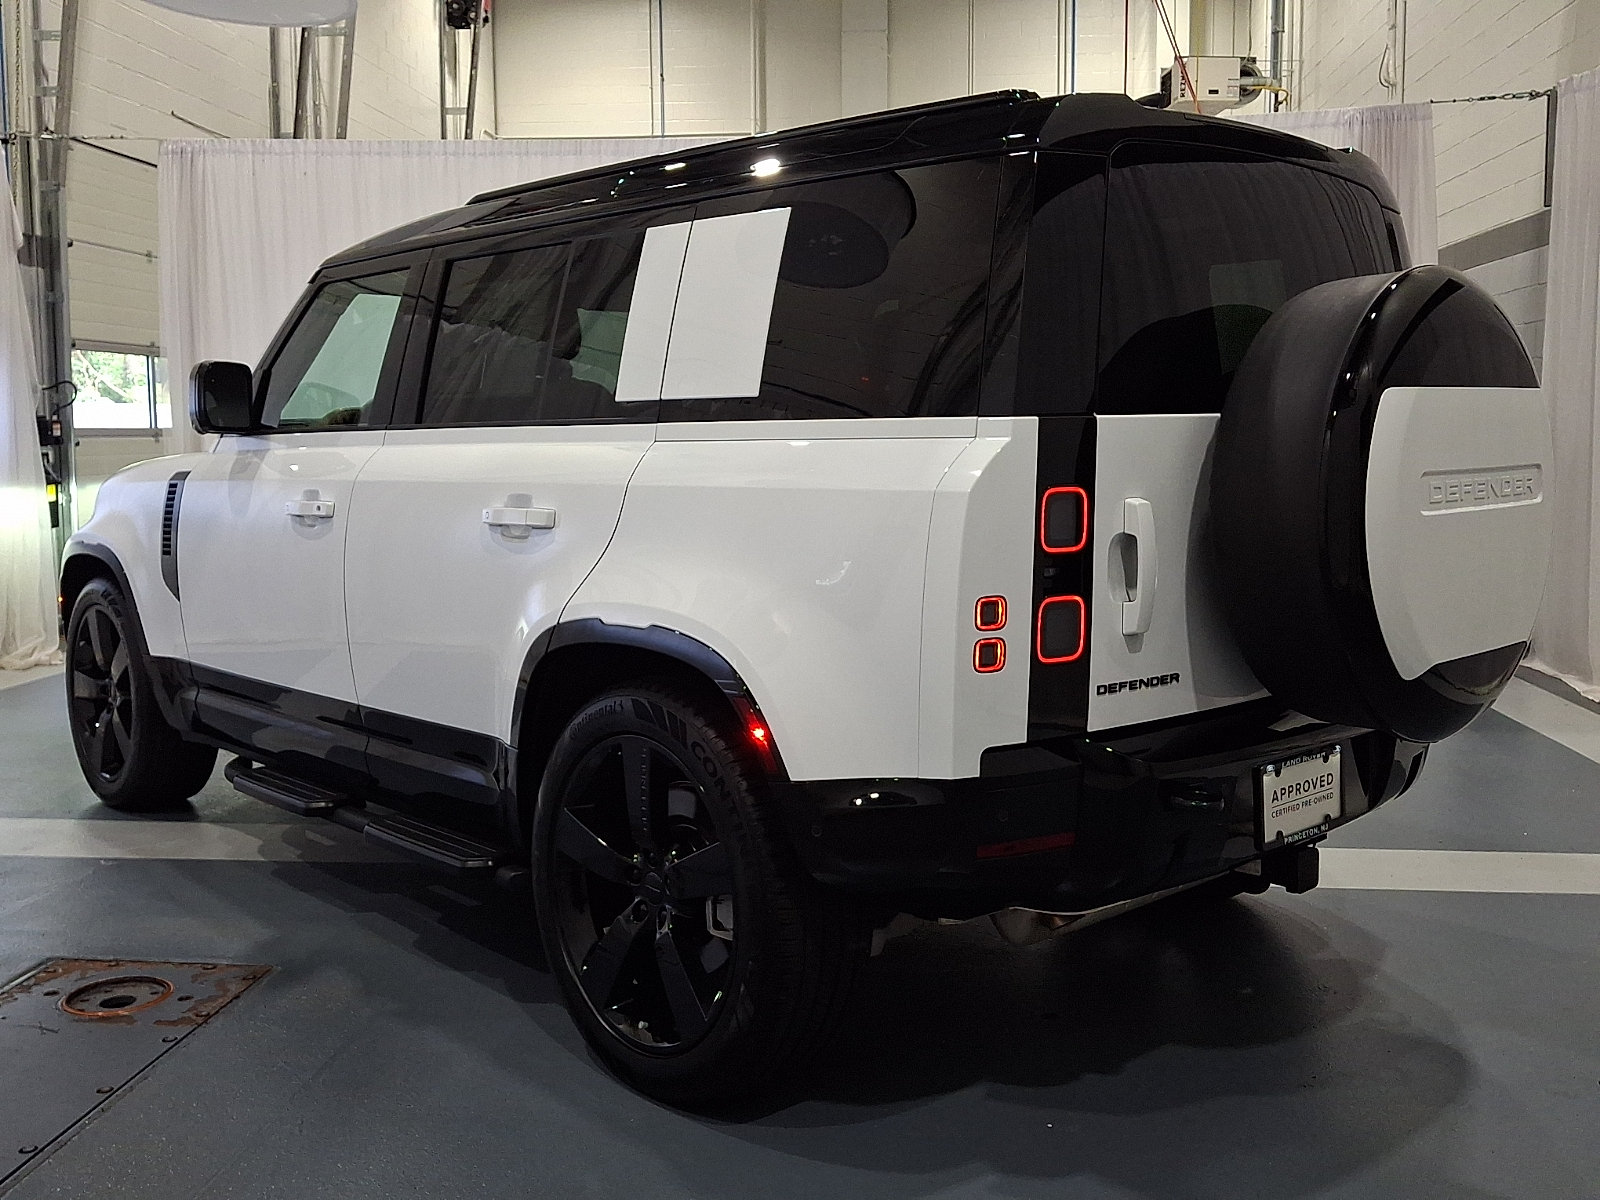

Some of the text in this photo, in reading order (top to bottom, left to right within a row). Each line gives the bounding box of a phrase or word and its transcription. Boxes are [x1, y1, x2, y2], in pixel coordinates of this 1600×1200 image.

[1428, 477, 1534, 505] DEFENDER
[1096, 672, 1181, 696] DEFENDER
[1281, 757, 1301, 768] LAND
[1271, 772, 1334, 804] APPROVED
[1271, 792, 1333, 818] CERTIFIED PRE-OWNED
[1320, 822, 1330, 832] NJ
